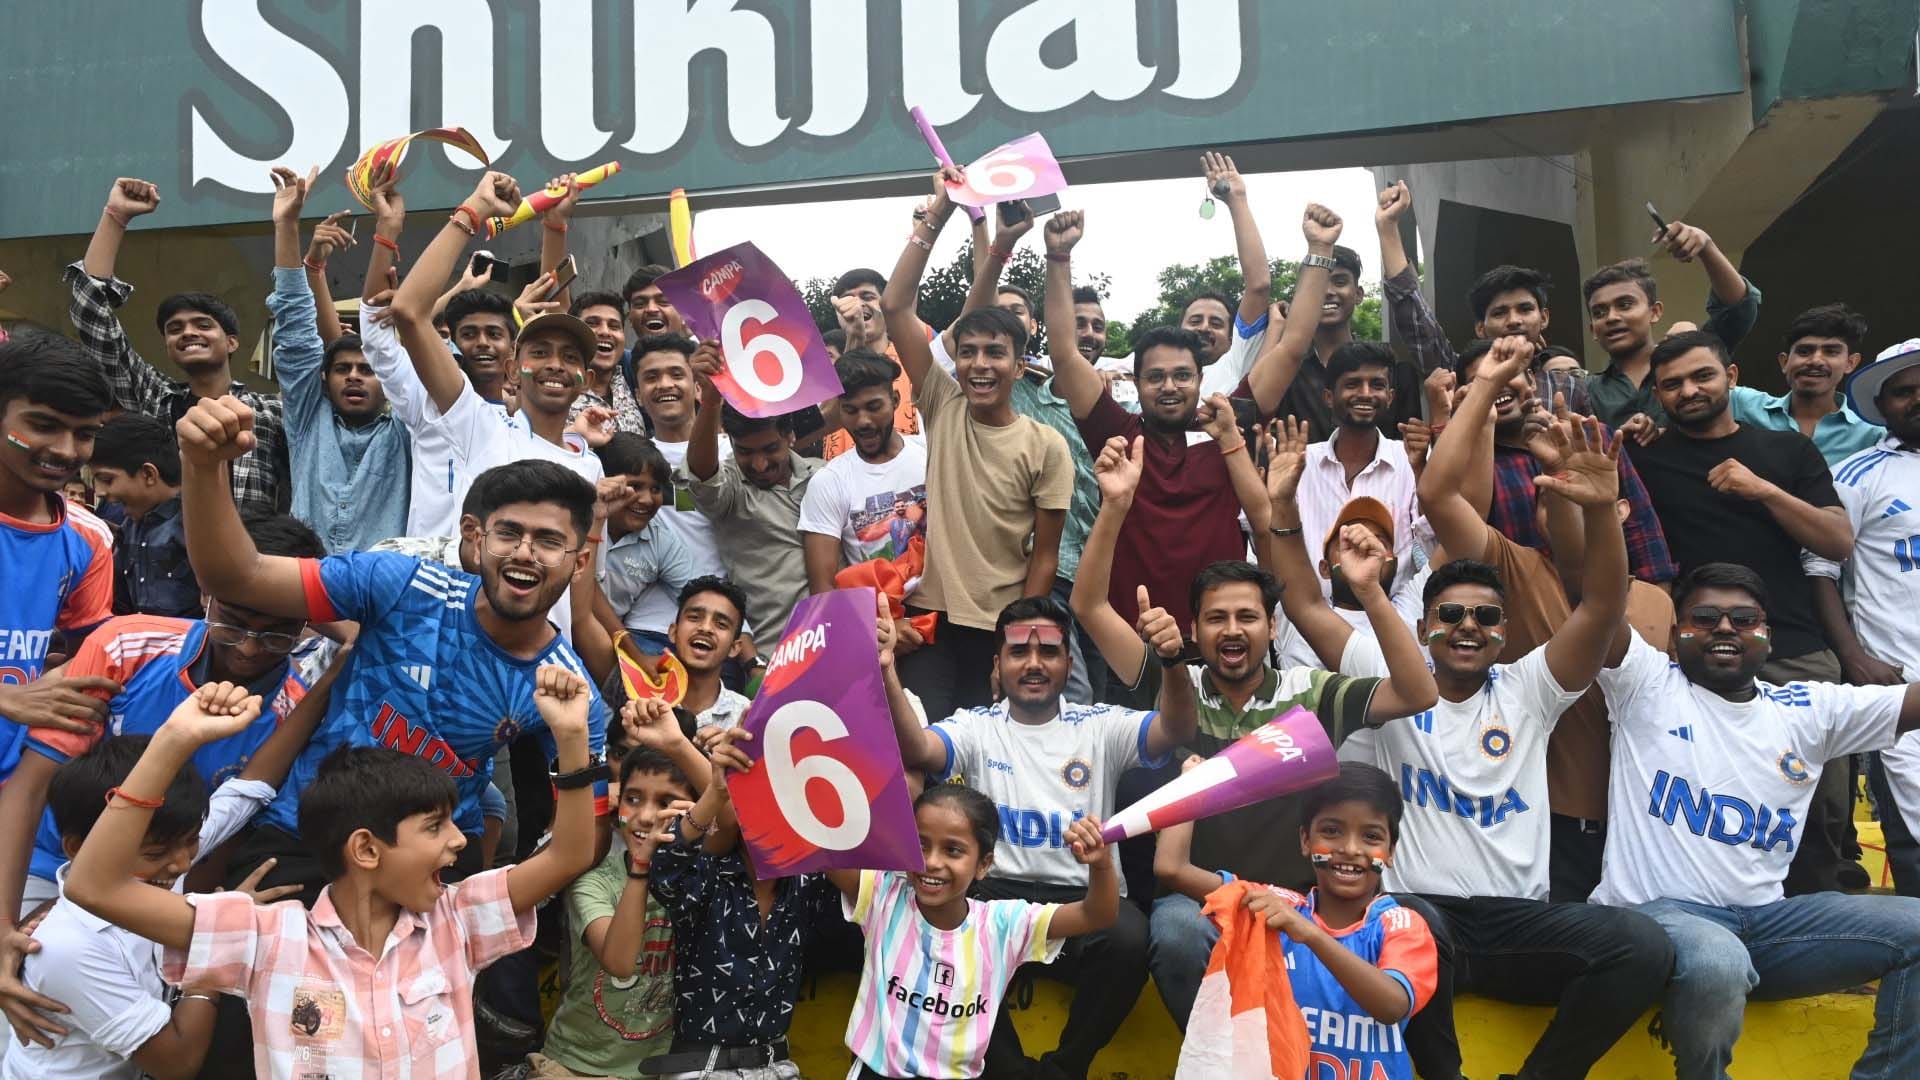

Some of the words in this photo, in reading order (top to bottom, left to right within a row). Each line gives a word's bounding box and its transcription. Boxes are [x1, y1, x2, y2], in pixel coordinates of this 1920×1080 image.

[966, 152, 1036, 197] 6
[702, 259, 743, 296] CAMPA
[721, 299, 803, 402] 6
[371, 700, 476, 778] INDI
[764, 700, 871, 851] 6
[1649, 769, 1798, 853] INDIA
[887, 975, 988, 1018] facebook
